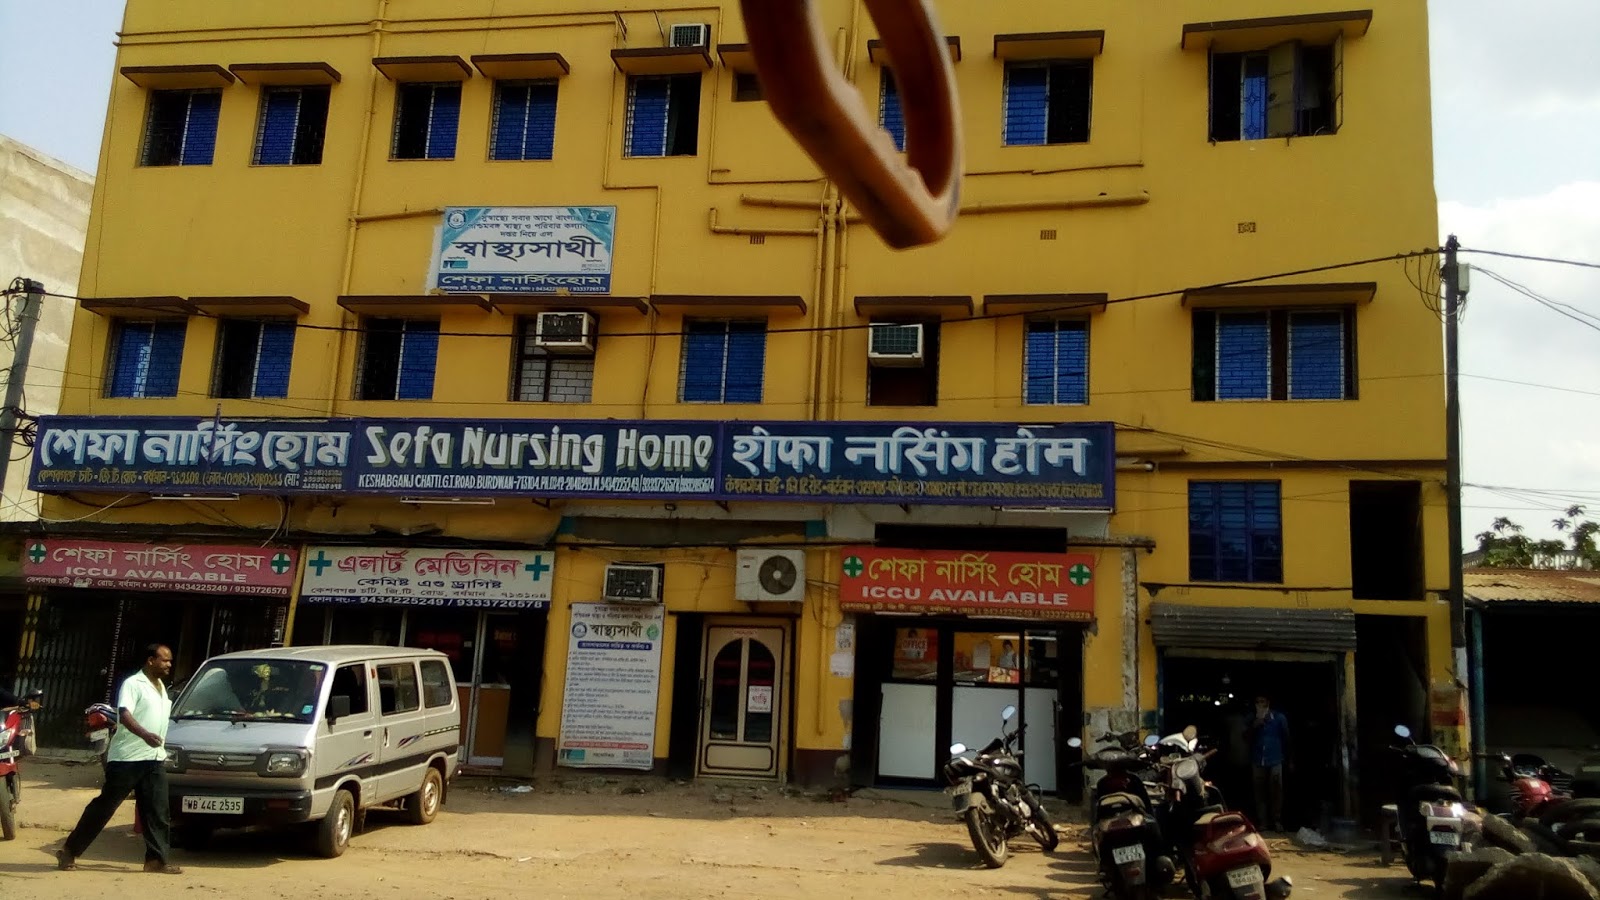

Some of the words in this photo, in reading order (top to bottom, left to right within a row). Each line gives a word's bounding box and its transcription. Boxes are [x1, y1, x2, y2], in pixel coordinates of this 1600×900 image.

[452, 235, 603, 262] স্বাস্থ্যসাথী
[441, 275, 495, 286] শেফা
[41, 428, 140, 468] শেফা
[365, 425, 454, 468] Sefa
[460, 425, 606, 473] Nursing
[615, 428, 715, 472] Home
[732, 426, 834, 477] शेफा
[845, 426, 988, 478] नर्सिंग
[990, 427, 1094, 477] होम
[358, 474, 414, 488] KESHABGANJ
[52, 546, 117, 563] শেফা
[123, 547, 195, 570] নার্সিং
[204, 552, 266, 572] হোম
[337, 549, 410, 575] এলার্ট
[414, 551, 523, 577] মেডিসিন
[65, 566, 118, 577] ICCU
[124, 569, 248, 583] AVAILABLE
[868, 556, 928, 584] শেফা
[934, 553, 1000, 587] নার্সিং
[1007, 560, 1064, 589] হোম
[174, 583, 228, 593] 9434225249
[234, 585, 288, 595] 9333726578
[861, 585, 921, 599] ICCU
[928, 588, 1069, 606] AVAILABLE
[308, 596, 332, 604] ফোন
[360, 596, 444, 606] 9434225249
[456, 598, 543, 609] 9333726578
[590, 621, 643, 639] স্বাস্থ্যসাথী
[187, 800, 198, 810] WB
[201, 800, 217, 811] 44E
[219, 800, 241, 811] 2535
